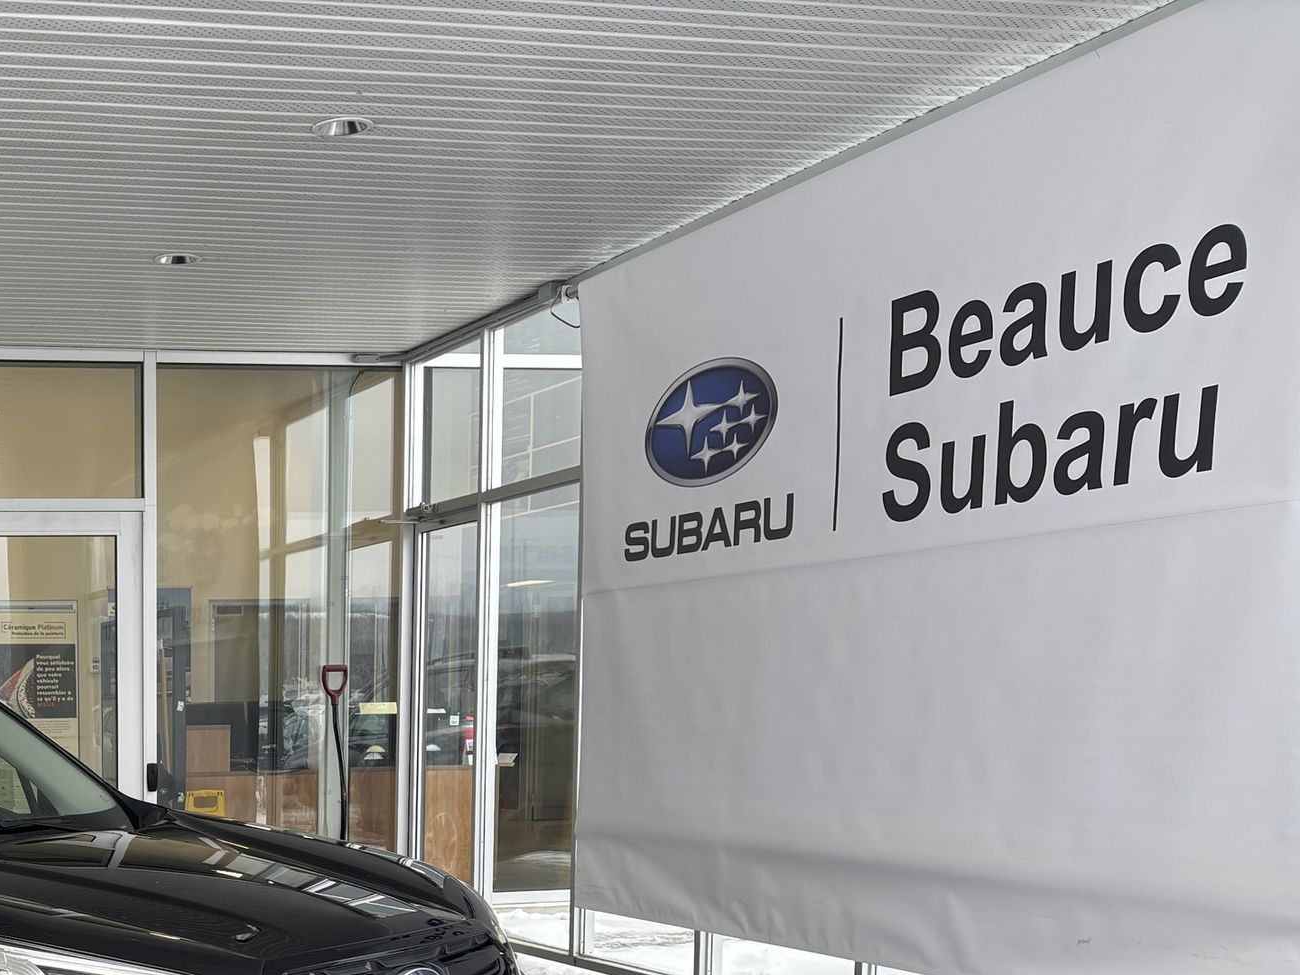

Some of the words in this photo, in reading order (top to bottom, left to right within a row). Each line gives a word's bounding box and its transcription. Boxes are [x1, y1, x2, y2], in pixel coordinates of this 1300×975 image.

[889, 223, 1247, 396] Beauce
[881, 384, 1219, 522] Subaru
[624, 493, 794, 562] SUBARU
[3, 623, 36, 631] Céramique
[37, 623, 64, 631] Platinum
